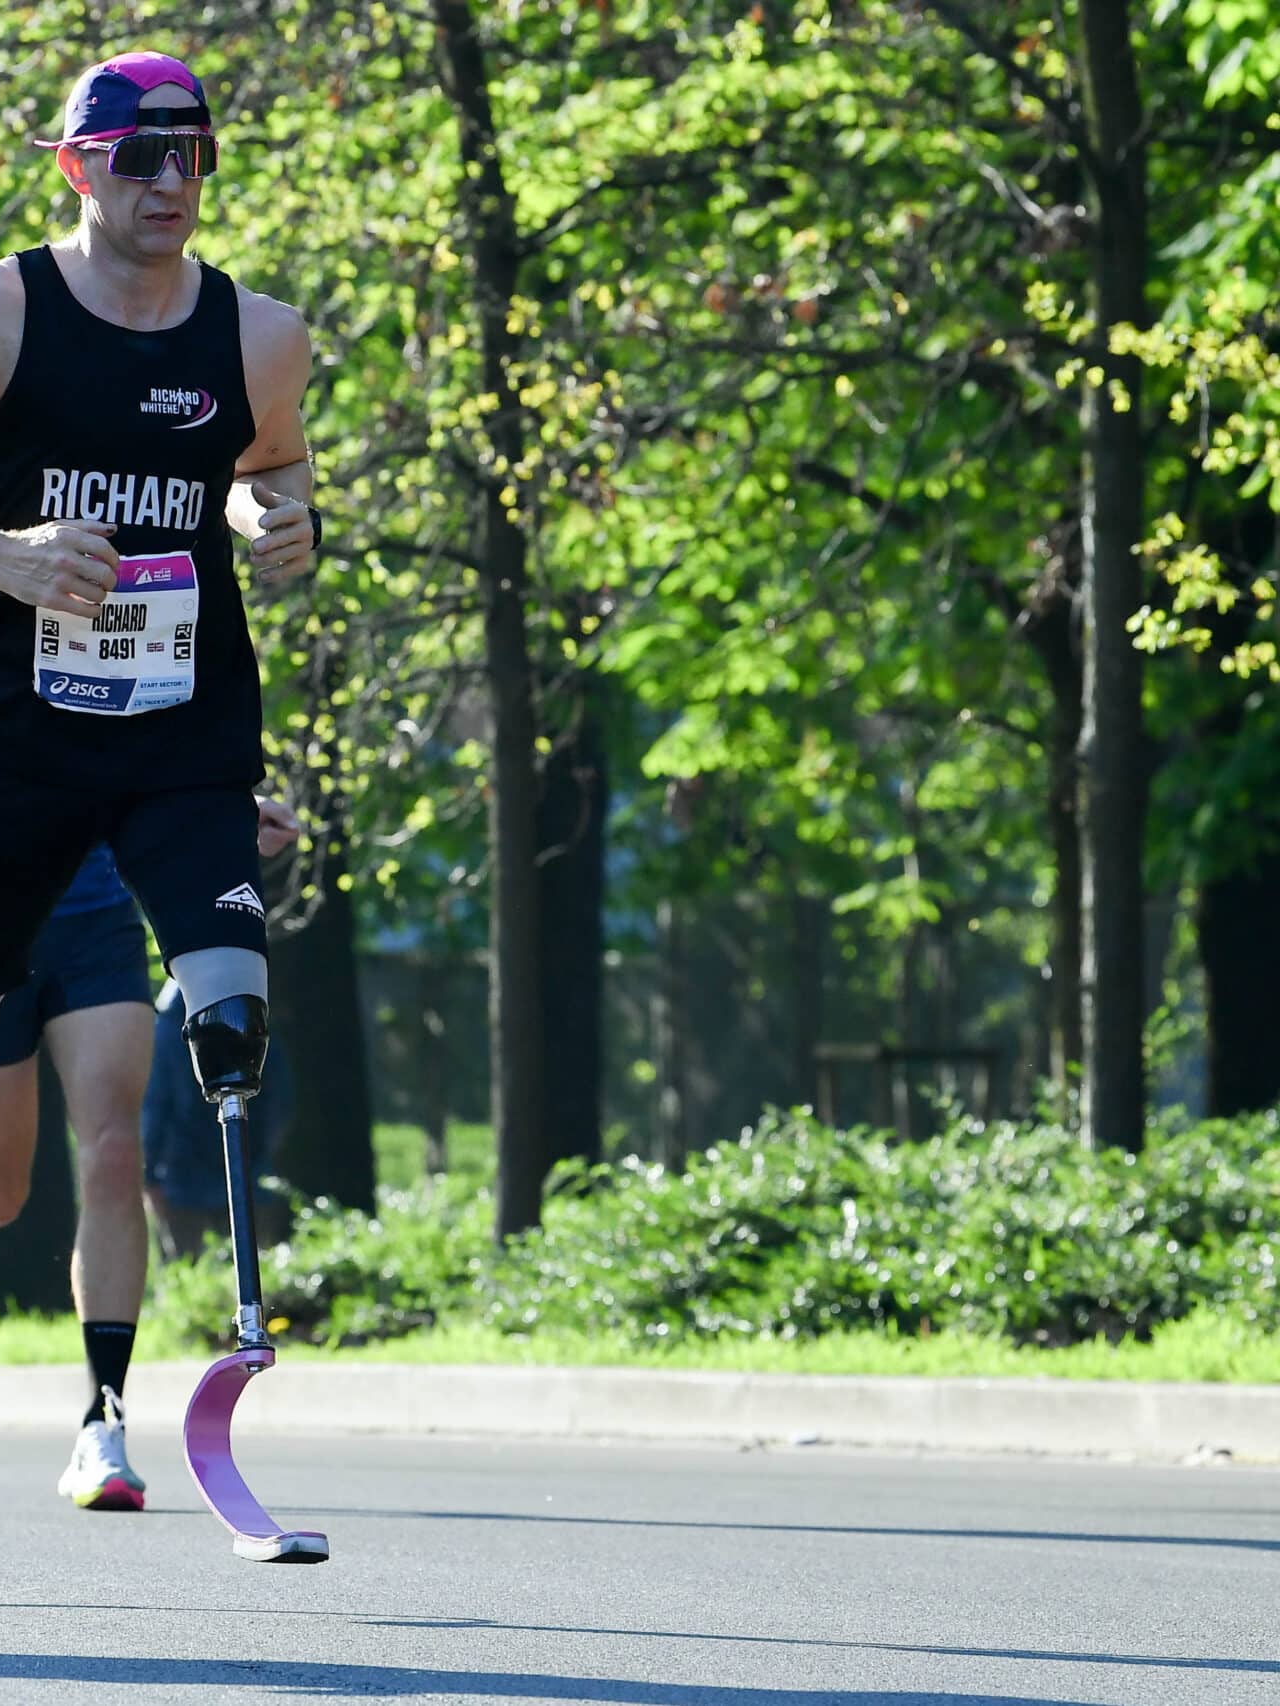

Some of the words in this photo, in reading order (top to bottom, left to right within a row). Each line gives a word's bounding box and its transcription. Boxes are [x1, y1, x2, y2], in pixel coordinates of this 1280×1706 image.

[150, 387, 200, 405] RICHARD
[40, 468, 205, 532] RICHARD
[99, 638, 136, 660] 8491
[68, 681, 111, 700] asics
[216, 902, 244, 911] NIKE
